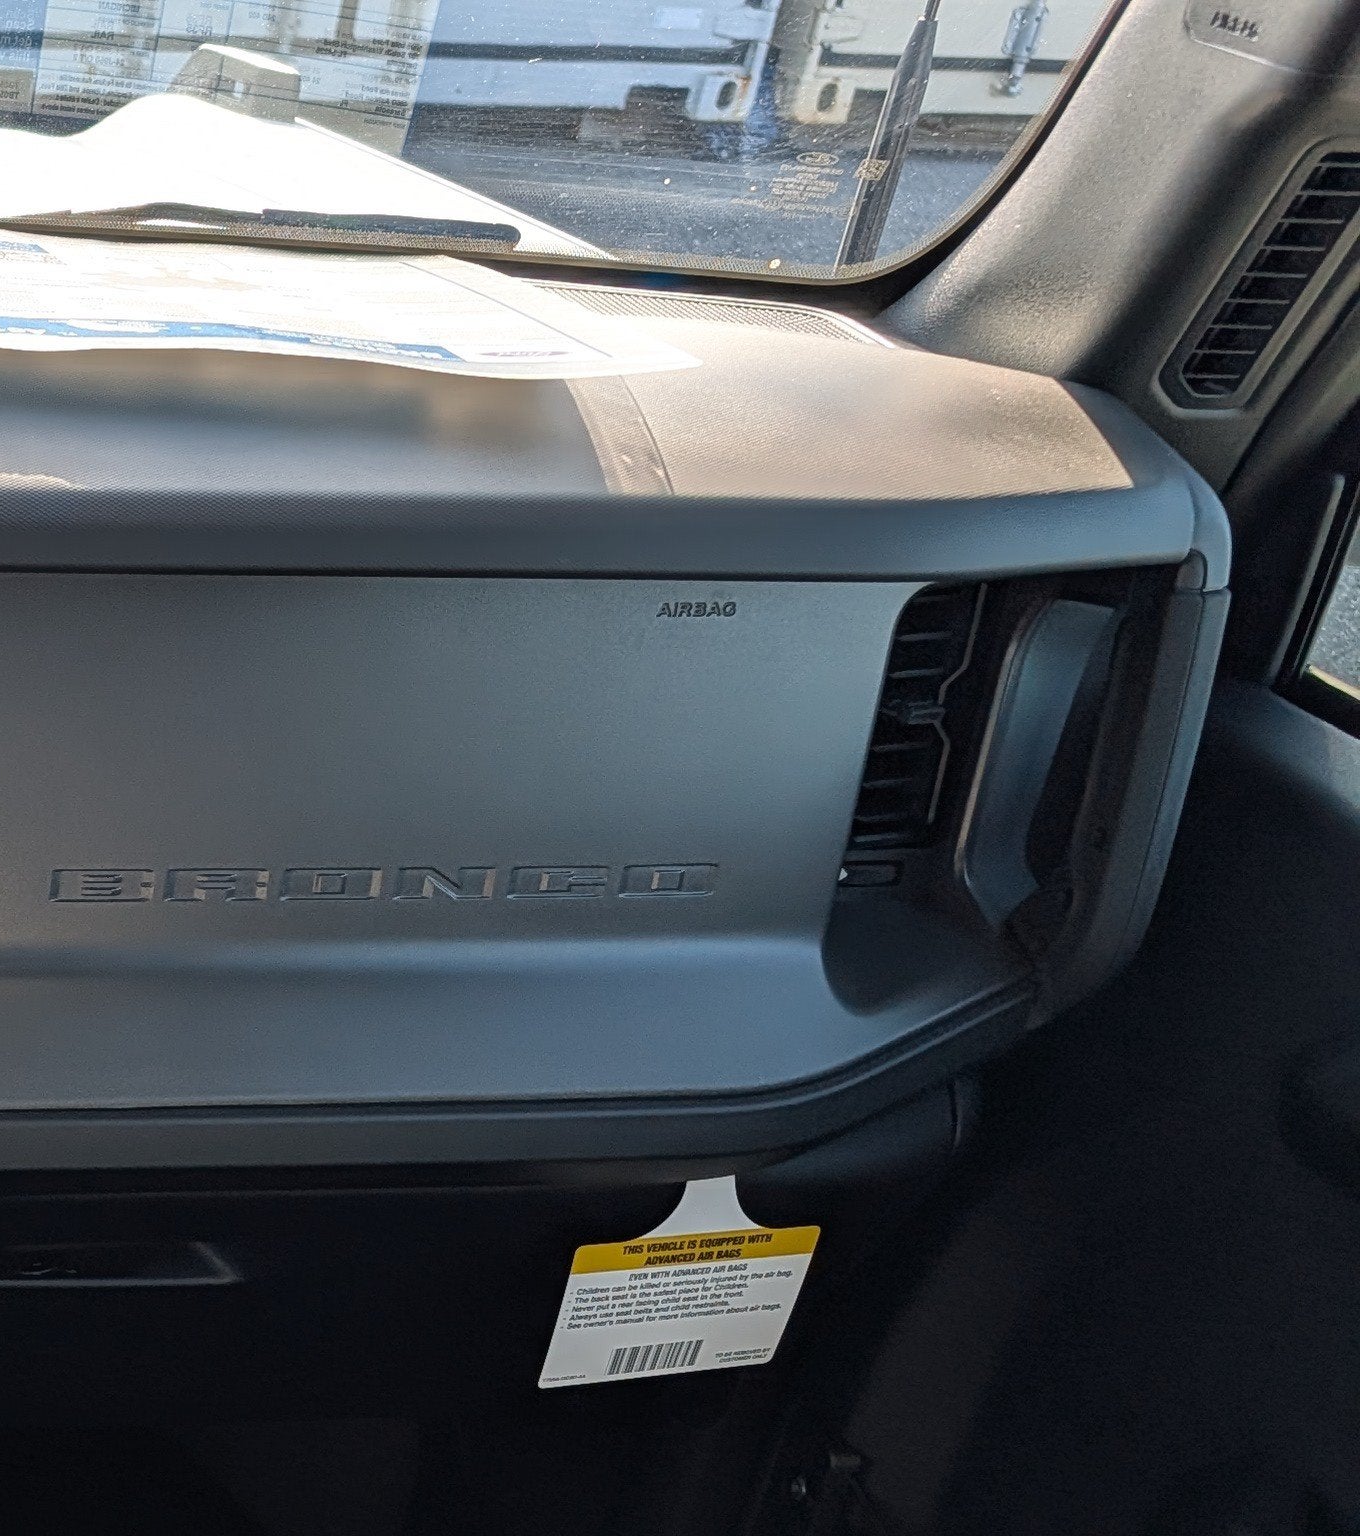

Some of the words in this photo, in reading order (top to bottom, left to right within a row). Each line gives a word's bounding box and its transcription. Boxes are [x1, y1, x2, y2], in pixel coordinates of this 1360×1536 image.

[657, 601, 737, 617] AIRBAG
[50, 863, 720, 901] BRONCO
[623, 1243, 644, 1255] THIS
[646, 1240, 685, 1253] VEHICLE
[687, 1239, 697, 1249] IS
[699, 1236, 745, 1250] EQUIPPED
[747, 1233, 772, 1245] WITH
[644, 1252, 695, 1266] ADVANCED
[697, 1250, 713, 1261] AIR
[715, 1249, 742, 1260] BAGS
[629, 1271, 649, 1281] EVEN
[650, 1269, 670, 1280] WITH
[671, 1266, 711, 1278] ADVANCED
[712, 1265, 726, 1274] AIR
[727, 1263, 748, 1273] BAGS
[577, 1286, 610, 1296] Children
